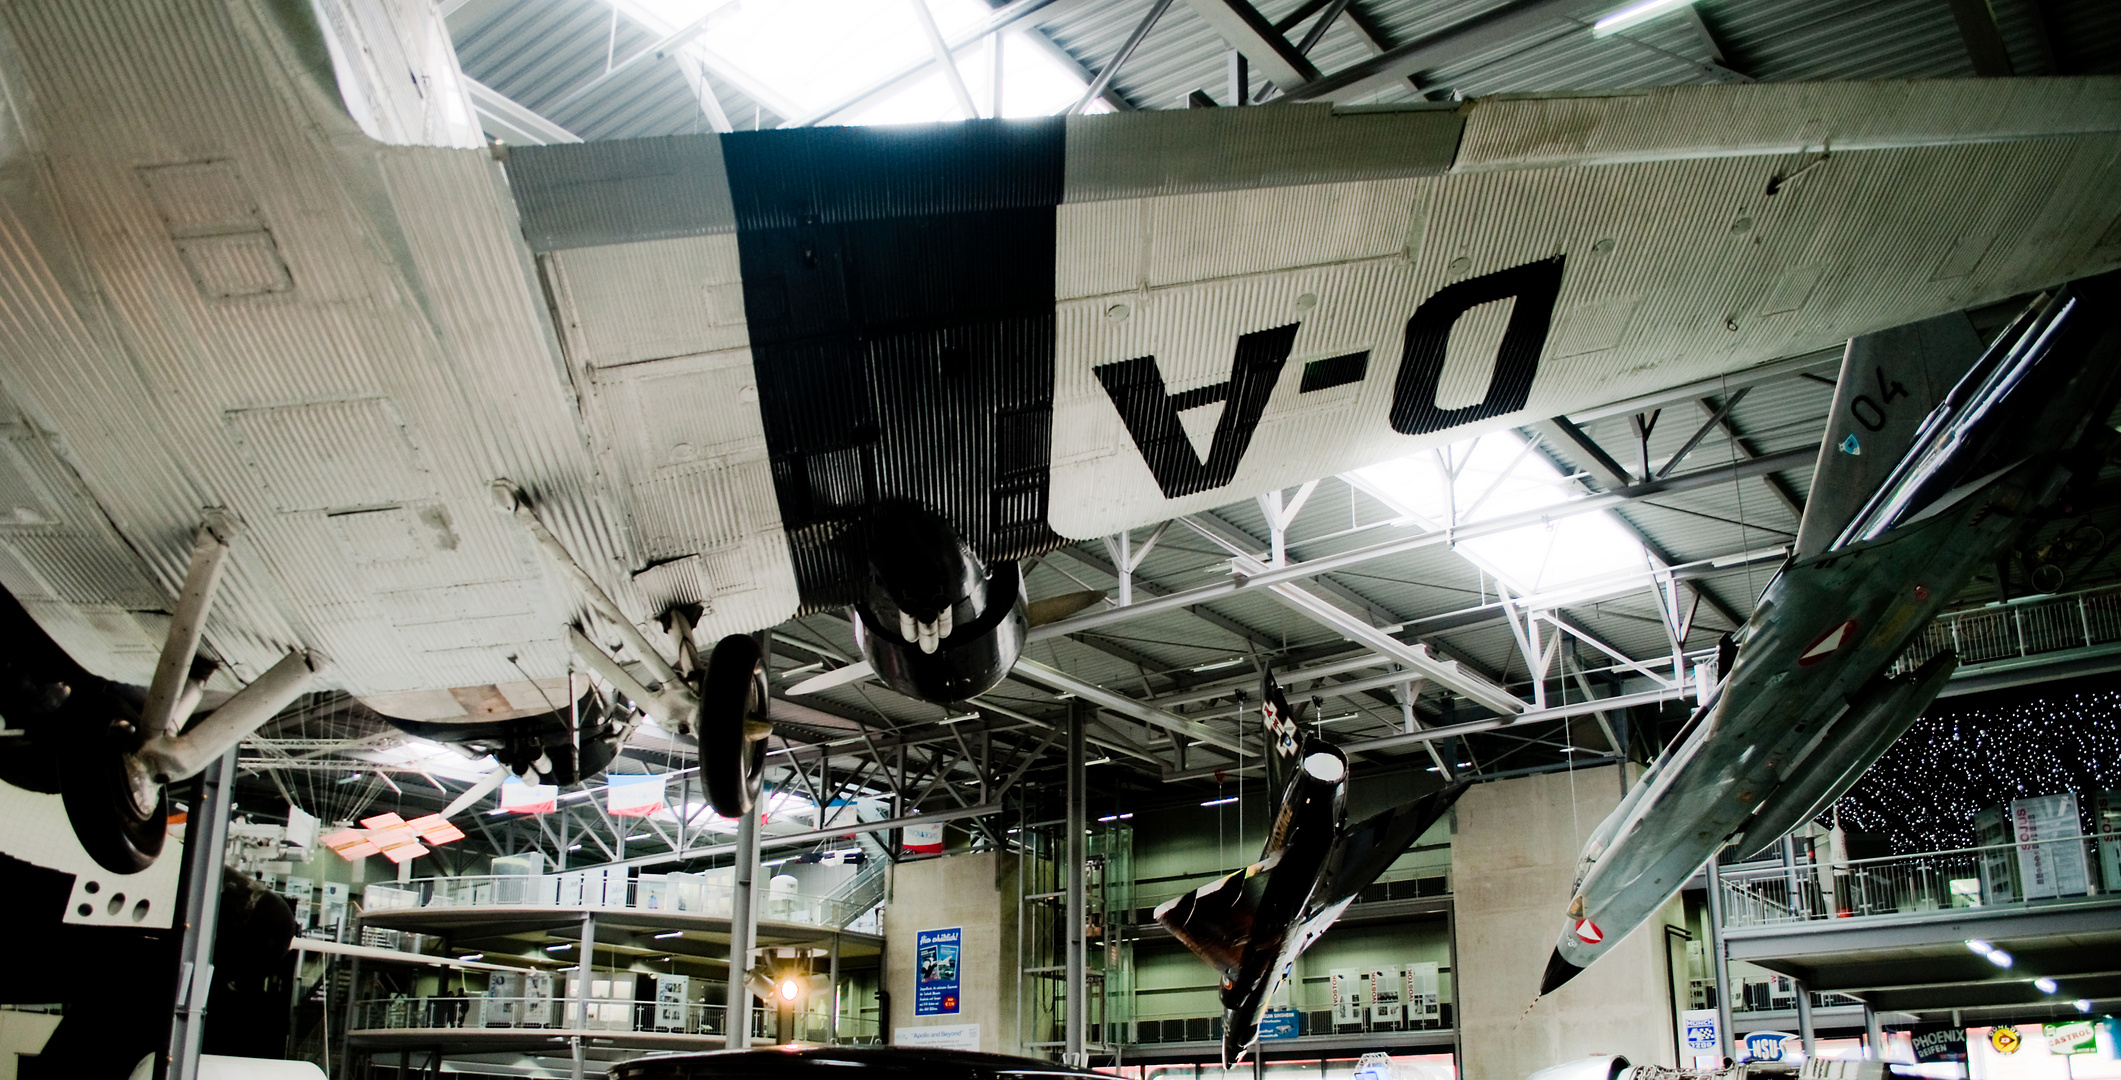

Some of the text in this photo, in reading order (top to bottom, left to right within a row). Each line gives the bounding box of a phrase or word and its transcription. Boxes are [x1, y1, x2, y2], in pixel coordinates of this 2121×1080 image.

[1092, 253, 1567, 500] D-A
[1850, 365, 1910, 432] 04
[2016, 808, 2031, 851] SOJUS
[1912, 1029, 1966, 1050] PHOENIX
[2048, 1028, 2092, 1046] CASTROL
[1752, 1038, 1779, 1060] NSU
[1917, 1043, 1948, 1059] REIFEN
